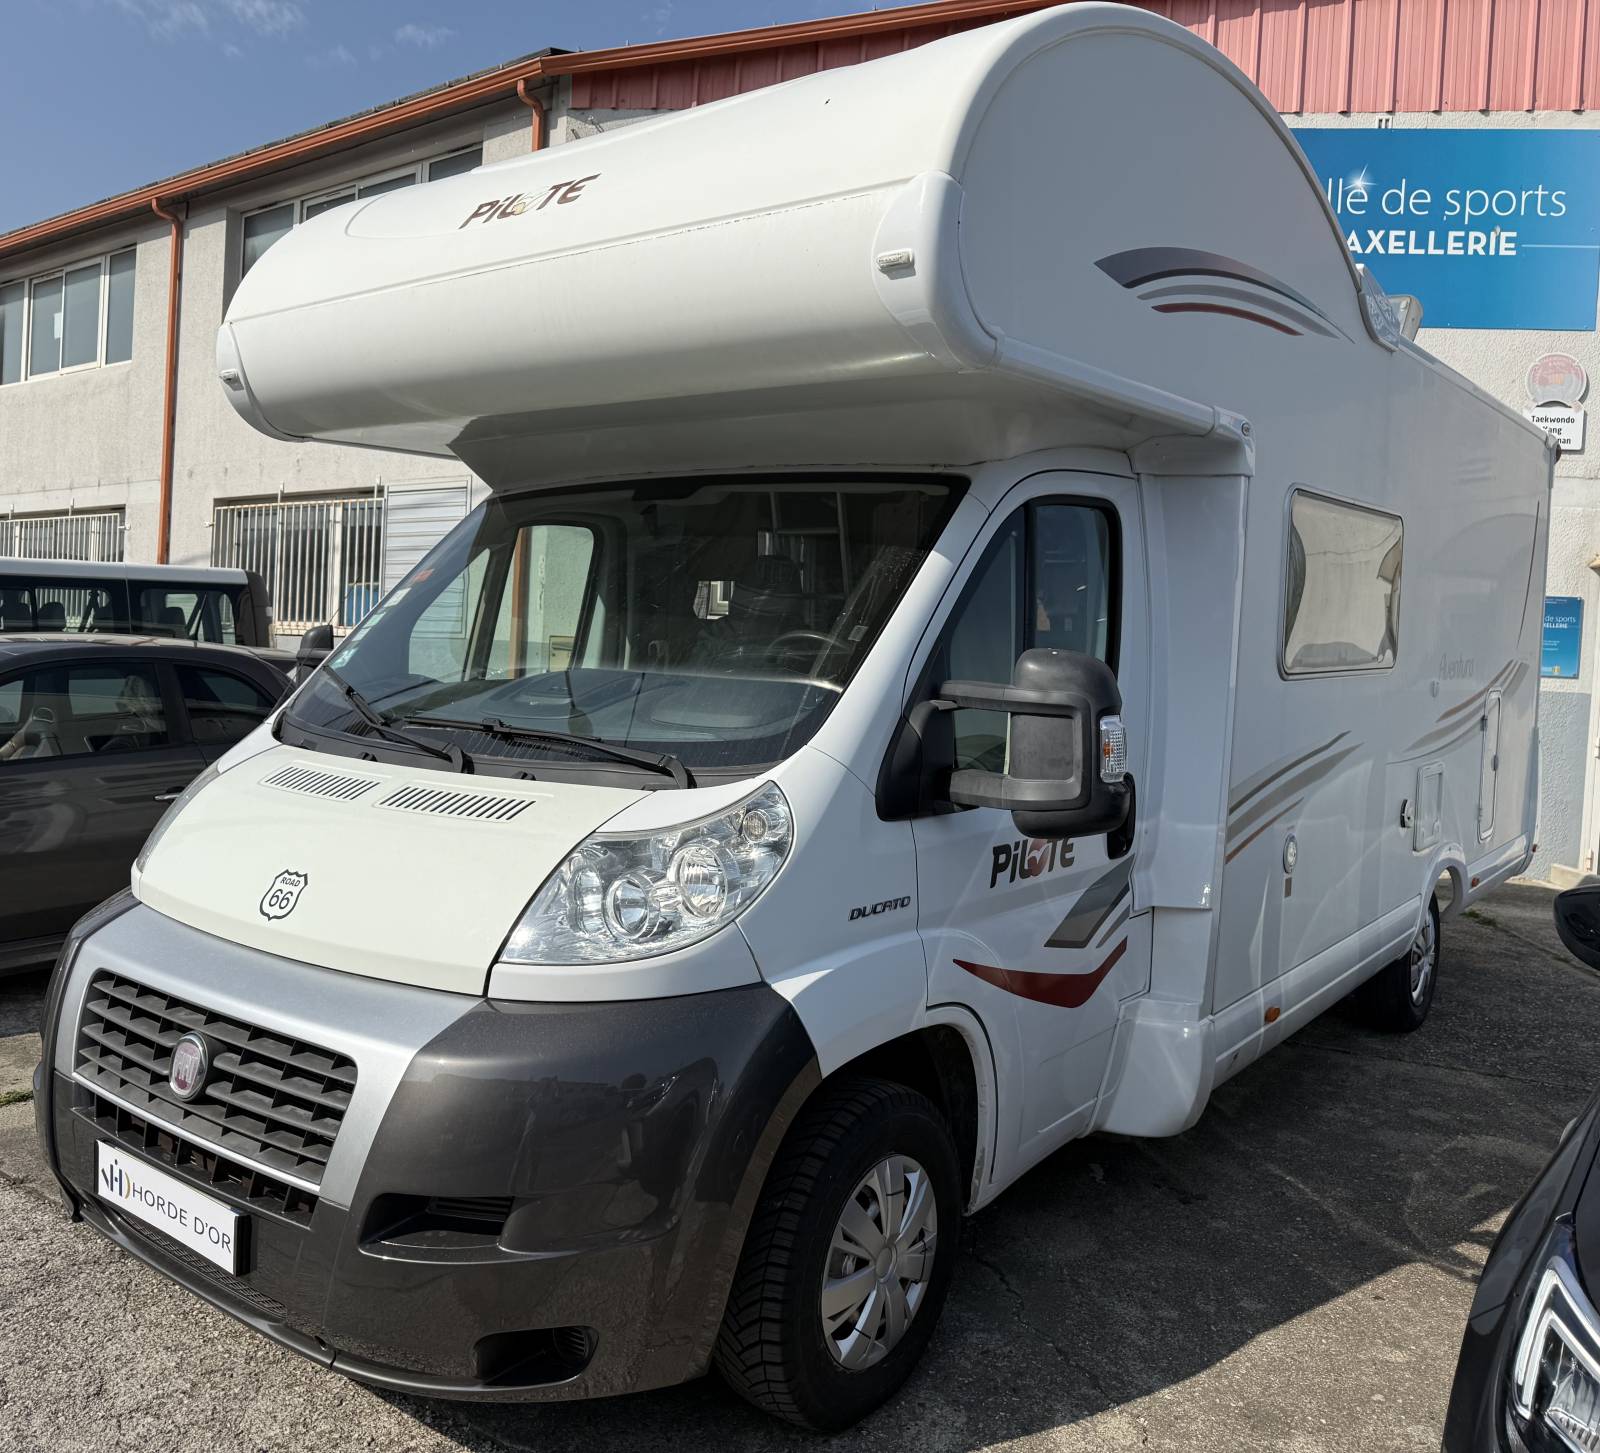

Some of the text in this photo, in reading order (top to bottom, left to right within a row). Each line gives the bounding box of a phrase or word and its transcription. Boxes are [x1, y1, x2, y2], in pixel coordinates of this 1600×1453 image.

[1328, 178, 1567, 225] lle de sports
[1347, 229, 1518, 256] AXELLERIE
[1531, 415, 1575, 424] Taekwondo
[280, 876, 301, 887] ROAD
[268, 888, 294, 910] 66
[849, 895, 911, 921] DUCATO
[132, 1182, 188, 1228] HORDE
[194, 1216, 232, 1254] D'OR
